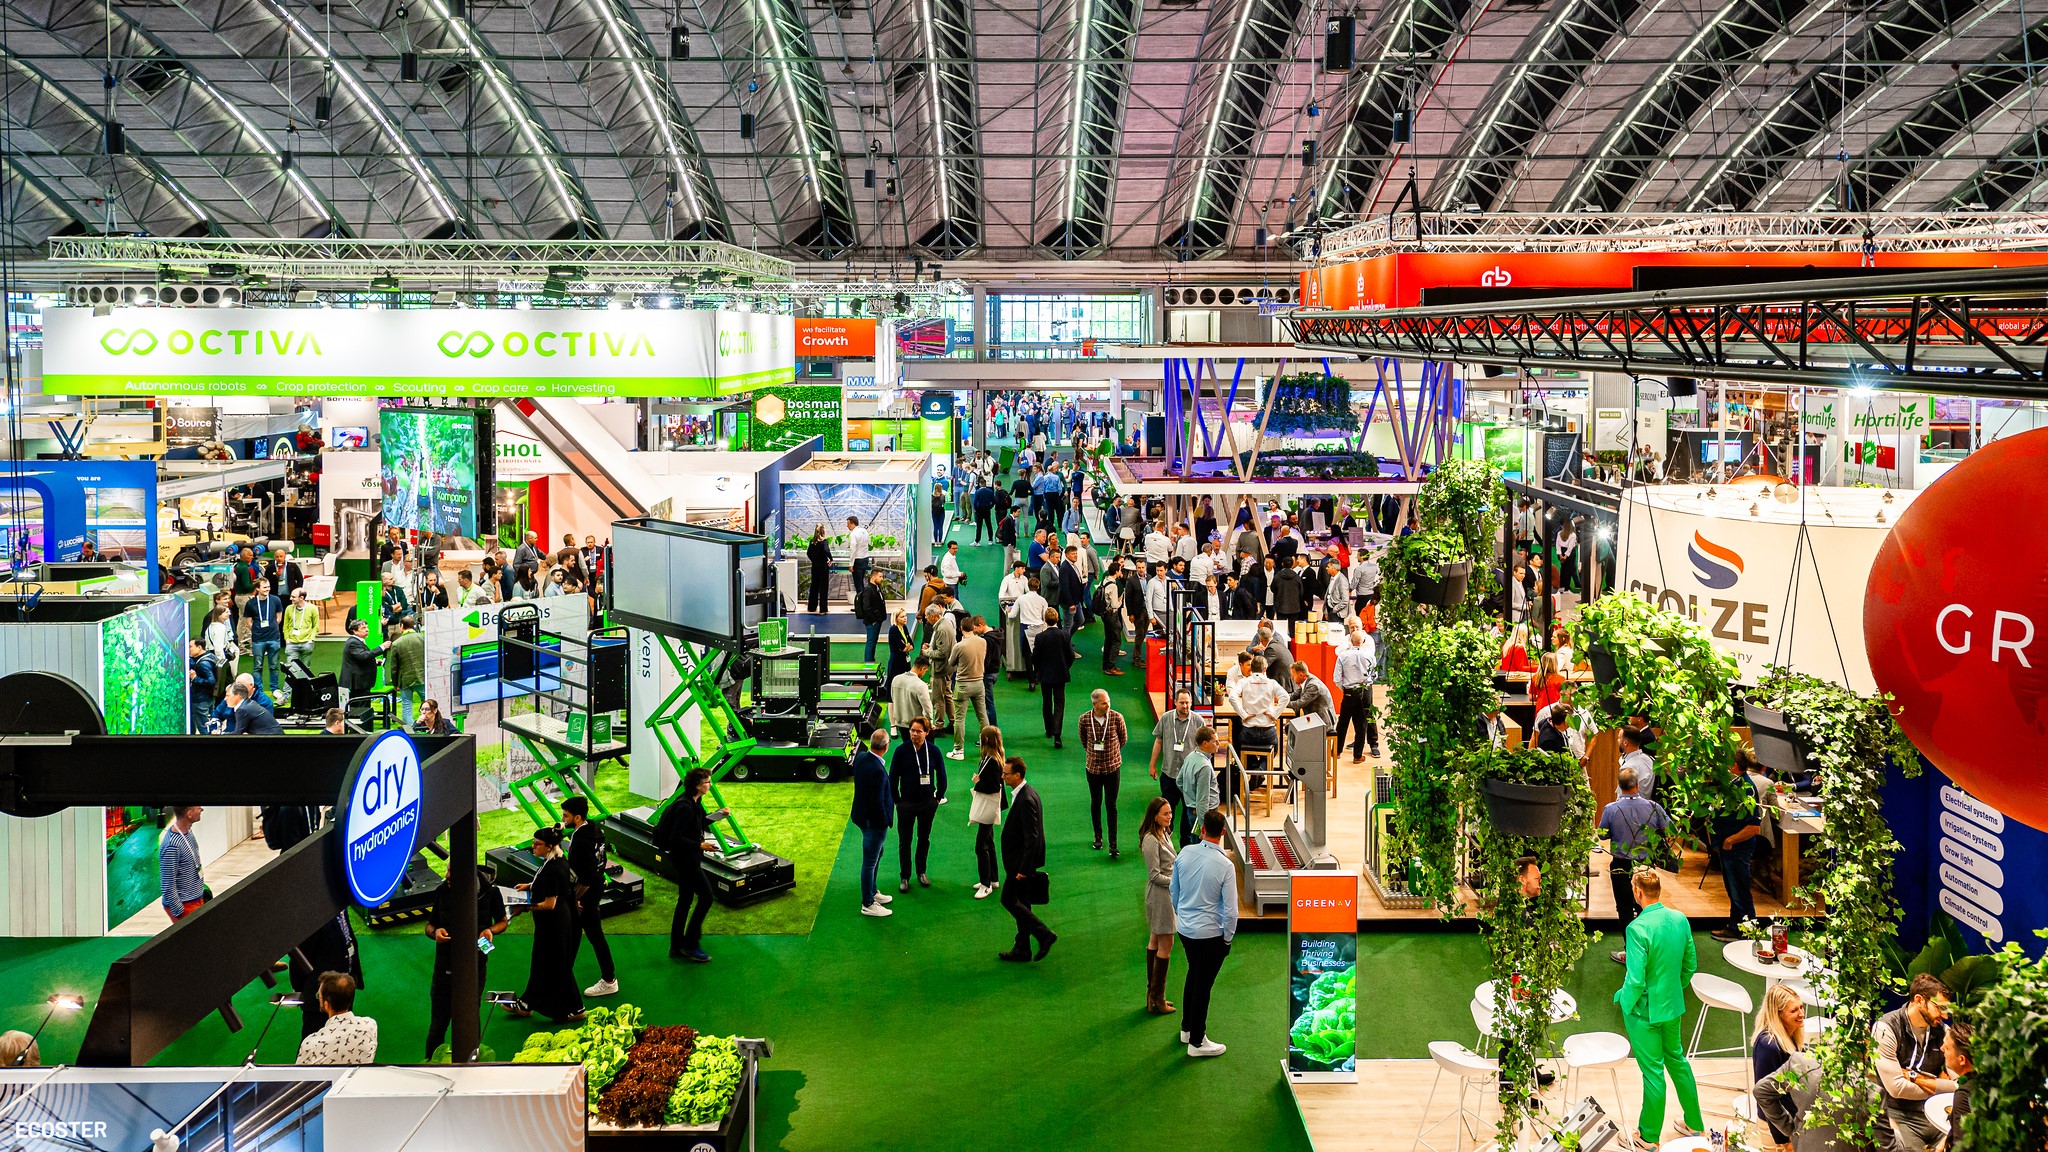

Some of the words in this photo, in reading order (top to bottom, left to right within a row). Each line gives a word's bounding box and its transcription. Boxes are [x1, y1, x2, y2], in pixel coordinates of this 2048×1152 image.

[1999, 322, 2020, 332] global
[168, 329, 323, 356] OCTIVA
[502, 331, 656, 357] OCTIVA
[802, 336, 849, 346] Growth
[124, 381, 205, 391] Autonomous
[208, 381, 247, 391] robots
[276, 382, 303, 394] Crop
[306, 381, 367, 394] protection
[393, 382, 447, 395] Scouting
[472, 383, 501, 395] Crop
[503, 385, 529, 393] care
[551, 383, 615, 396] Harvesting
[787, 399, 840, 409] bosman
[813, 408, 840, 418] zaal
[1800, 410, 1837, 430] Hortilife
[177, 418, 212, 428] Source
[1854, 412, 1924, 431] Hortilife
[363, 756, 408, 816] dry
[1945, 793, 1973, 813] Electrical
[1973, 805, 1998, 826] systems
[354, 807, 415, 862] hydroponics
[1945, 819, 1972, 839] Irrigation
[1972, 831, 1997, 852] systems
[1945, 844, 1960, 859] Grow
[1960, 851, 1974, 867] light
[1945, 870, 1979, 896] Automation
[1944, 896, 1966, 915] Climate
[1966, 907, 1989, 928] control
[1301, 940, 1336, 949] Building
[1301, 949, 1334, 959] Thriving
[15, 1121, 108, 1139] ECOSTER
